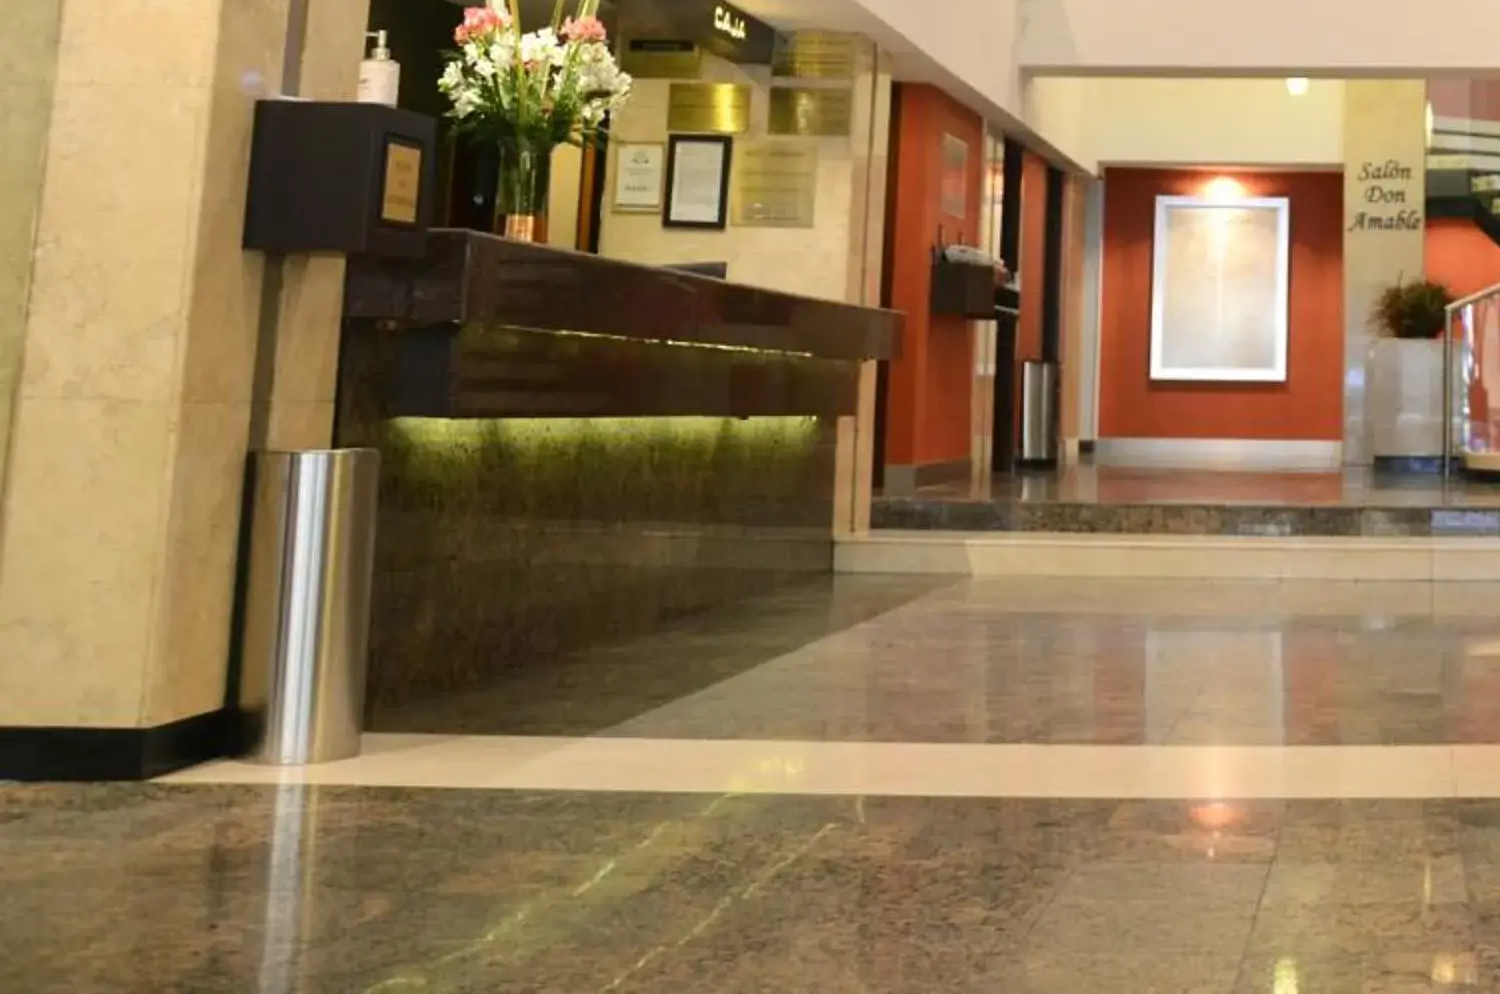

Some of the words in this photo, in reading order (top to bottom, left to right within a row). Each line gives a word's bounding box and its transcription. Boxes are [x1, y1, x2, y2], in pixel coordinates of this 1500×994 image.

[714, 6, 746, 39] CAJA
[1357, 159, 1412, 182] Salón
[1364, 185, 1406, 203] Don
[1347, 209, 1422, 233] Amable
